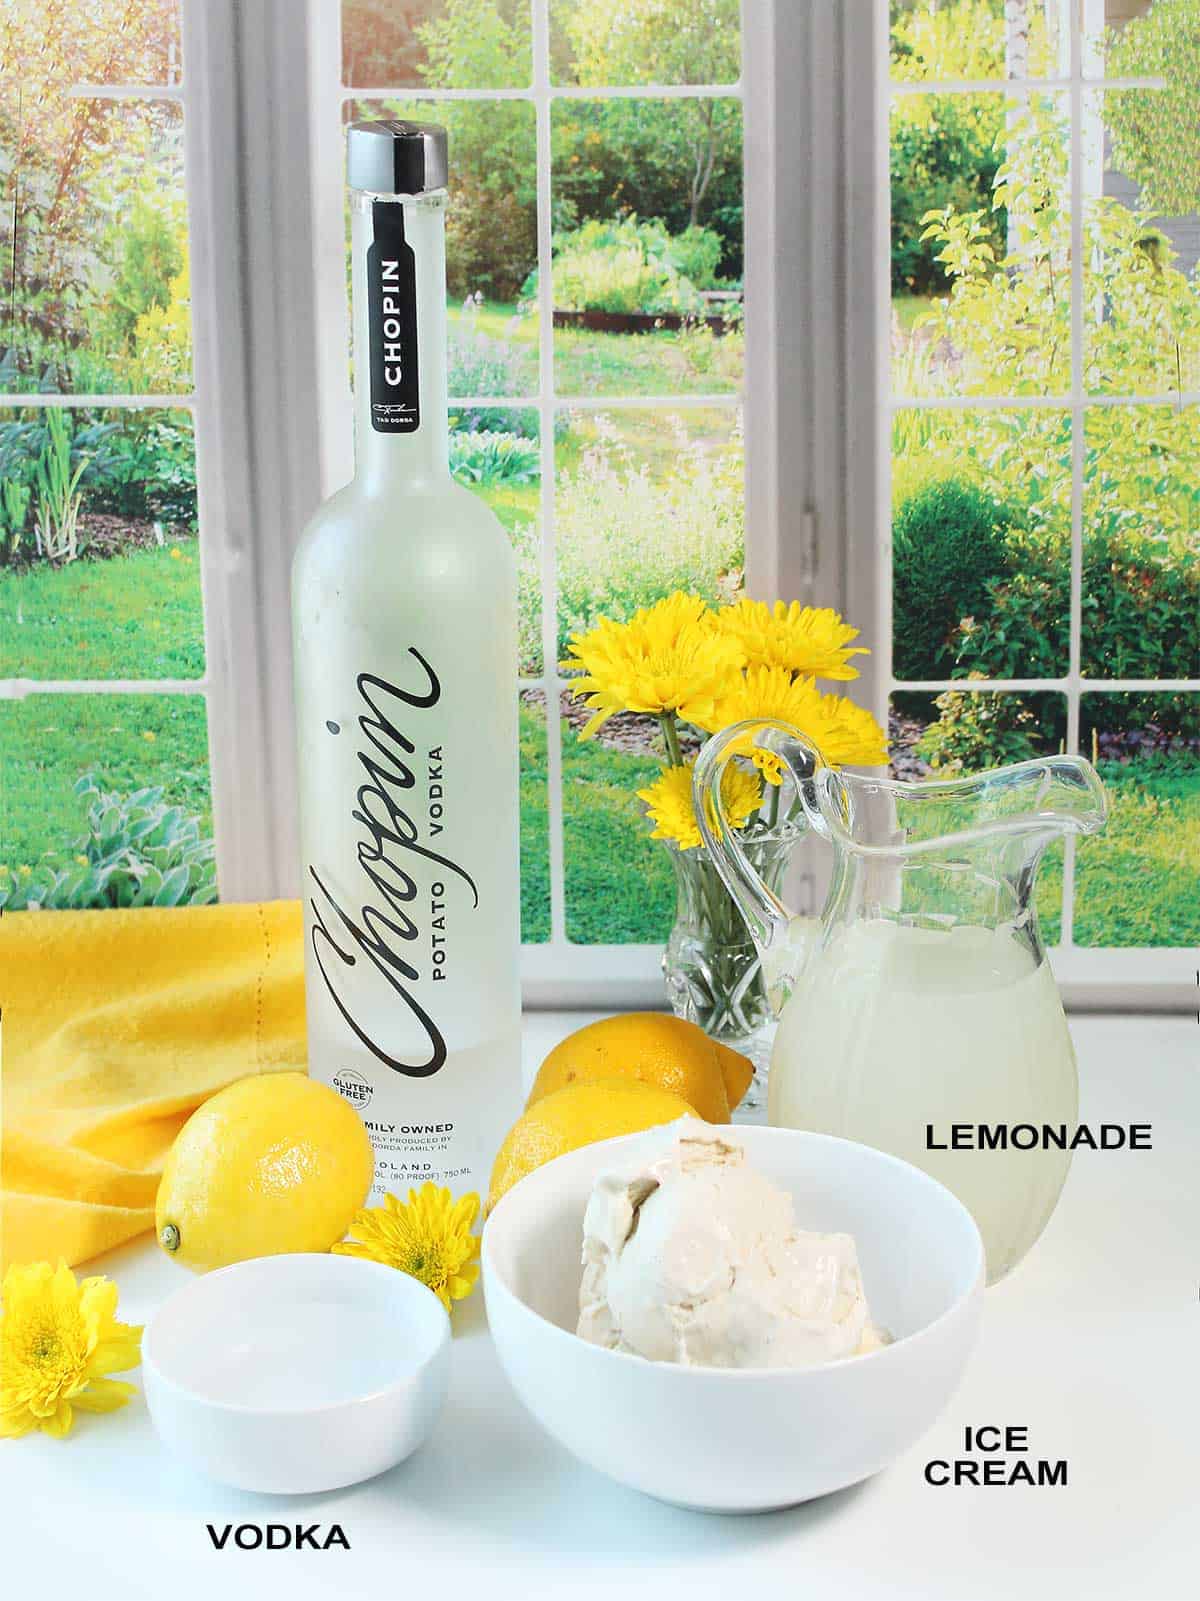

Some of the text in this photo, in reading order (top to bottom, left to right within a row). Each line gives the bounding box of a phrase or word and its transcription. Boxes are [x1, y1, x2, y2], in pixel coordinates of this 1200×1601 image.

[381, 260, 402, 386] CHOPIN
[310, 646, 478, 1078] Chopin
[428, 745, 446, 981] POTATO VODKA
[333, 1077, 374, 1094] GLUTEN
[339, 1087, 367, 1100] FREE
[364, 1121, 454, 1134] MILY OWNED
[389, 1137, 439, 1145] PRODUCED
[374, 1161, 432, 1171] OLAND
[443, 1170, 460, 1179] 750
